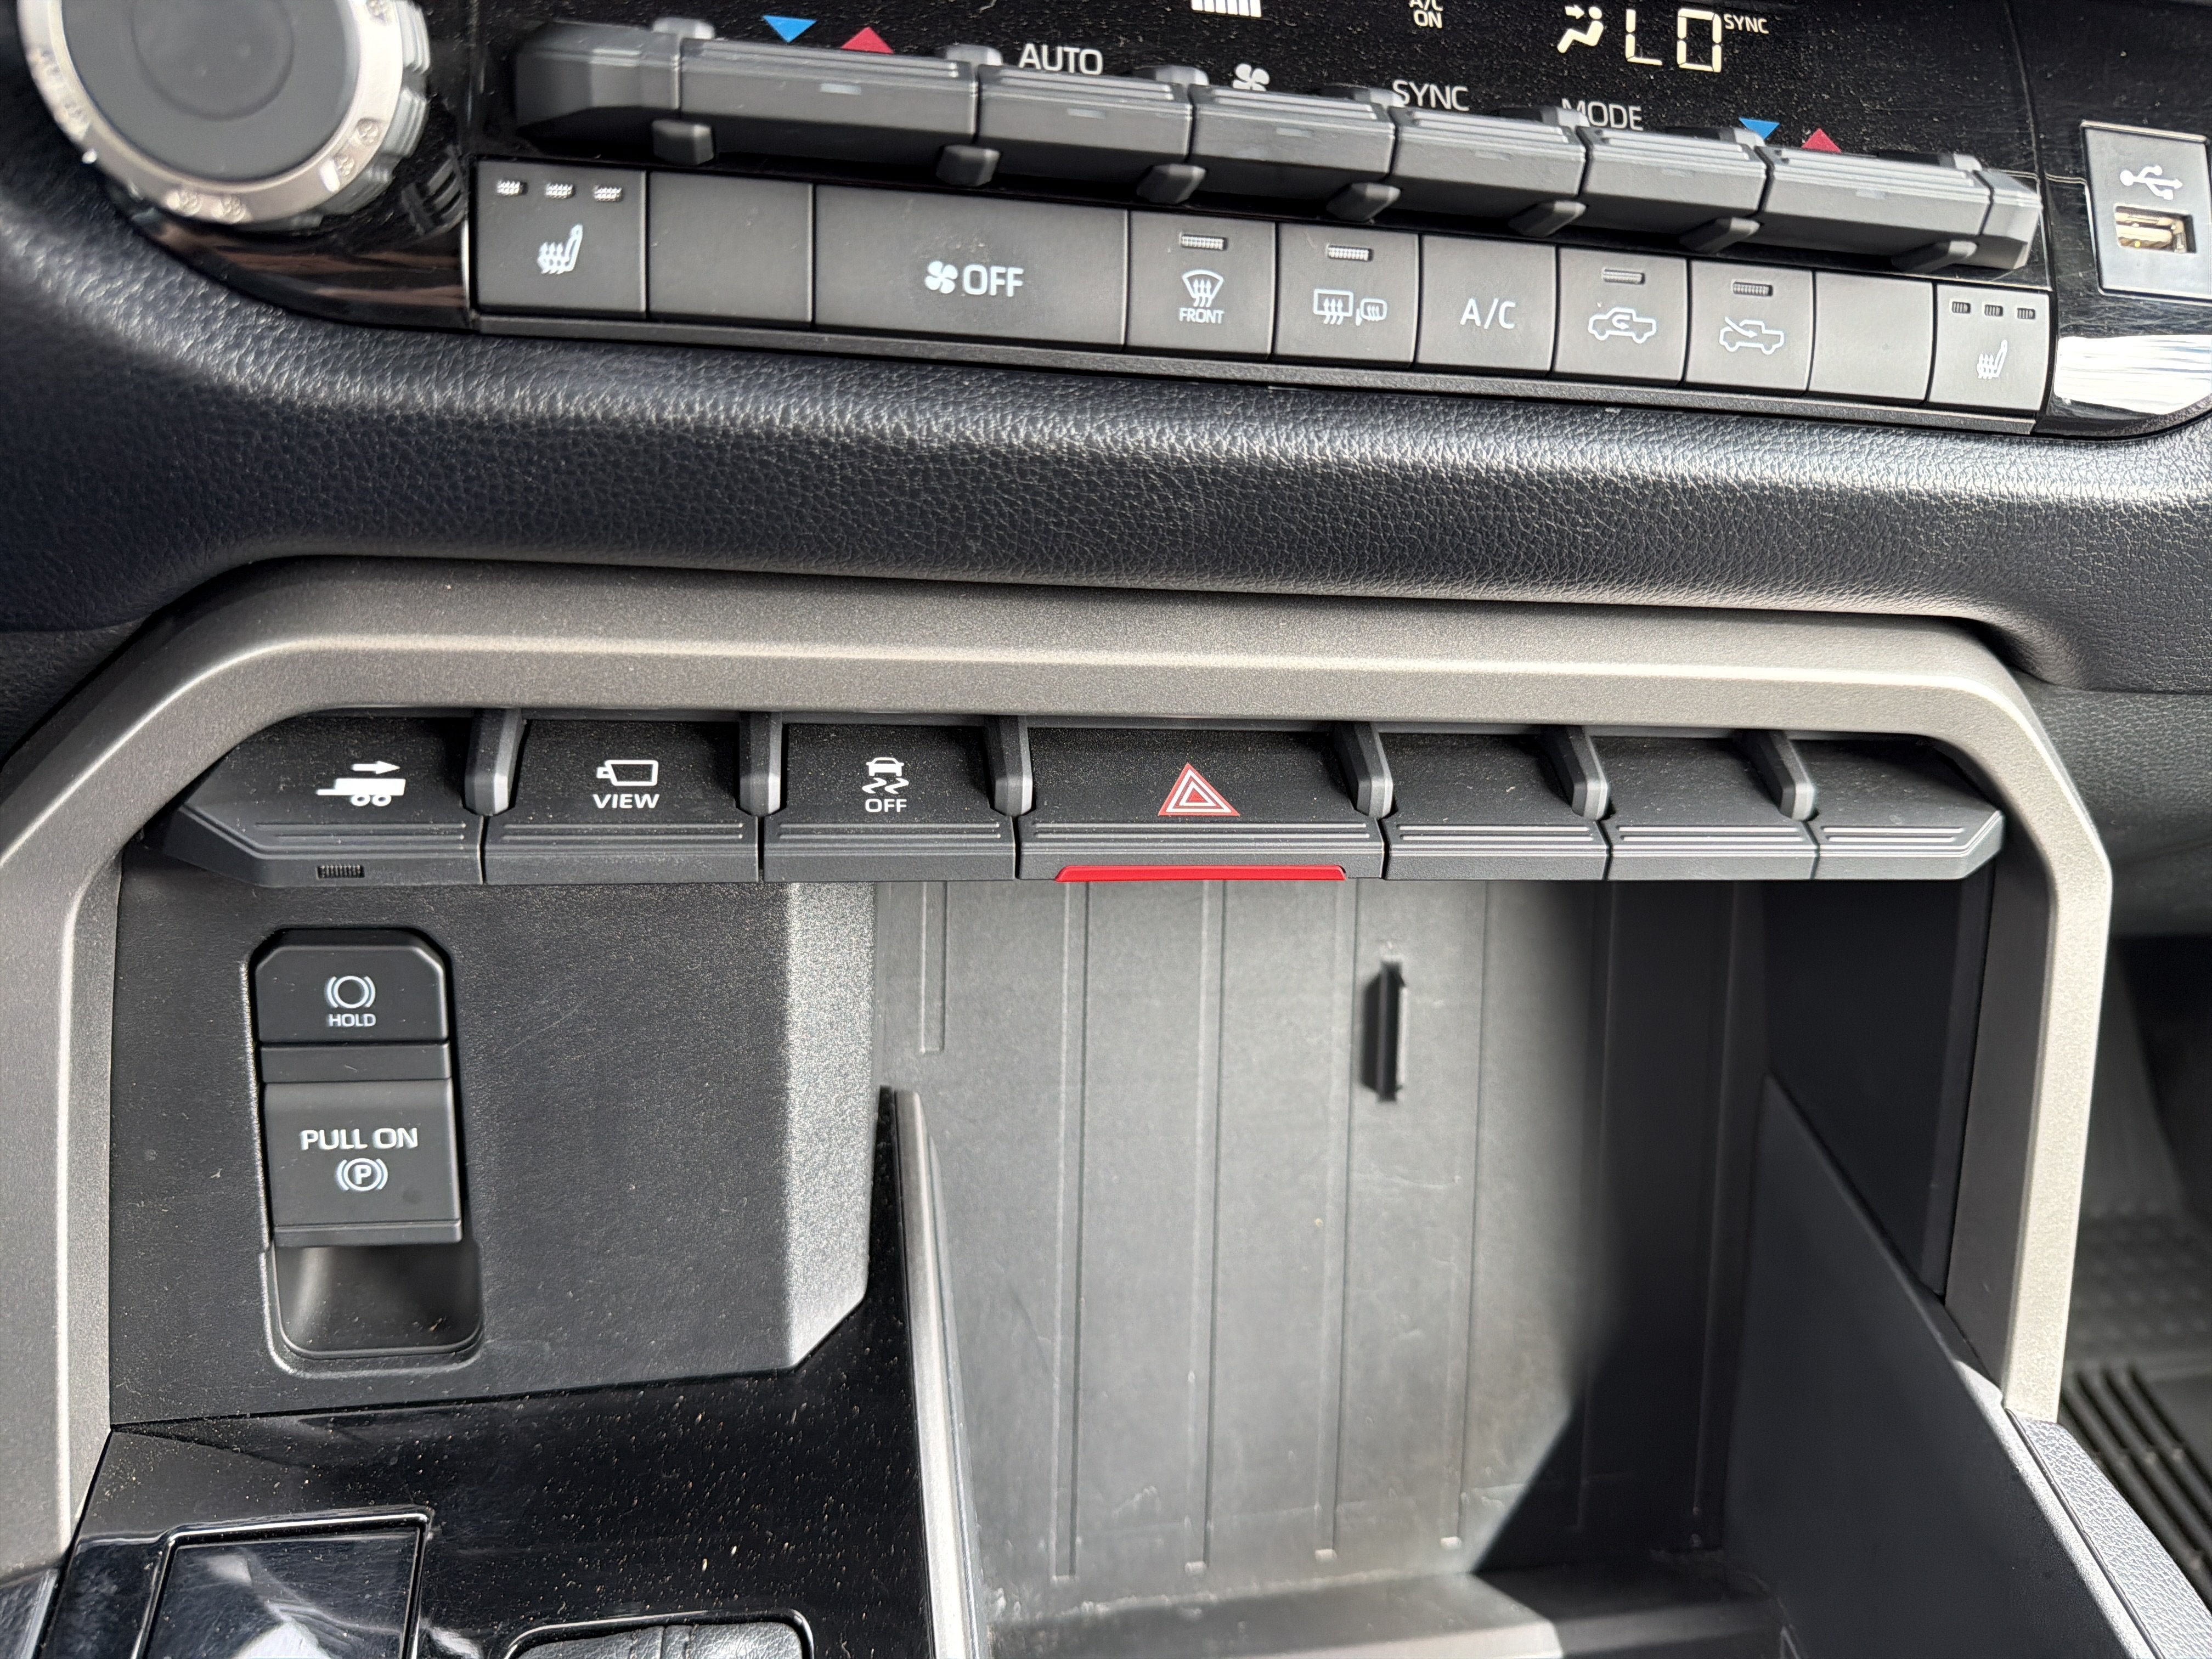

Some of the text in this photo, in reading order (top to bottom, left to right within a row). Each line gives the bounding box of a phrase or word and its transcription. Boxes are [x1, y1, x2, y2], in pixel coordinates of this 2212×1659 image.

[1414, 10, 1443, 29] ON
[1724, 13, 1769, 35] SYNC
[1019, 43, 1103, 75] AUTO
[1392, 79, 1470, 111] SYNC
[962, 265, 1024, 297] OFF
[1179, 307, 1224, 324] FRONT
[1460, 299, 1516, 329] A/C
[593, 794, 659, 809] VIEW
[865, 798, 907, 813] OFF
[329, 1013, 376, 1027] HOLD
[300, 1127, 419, 1150] PULL ON
